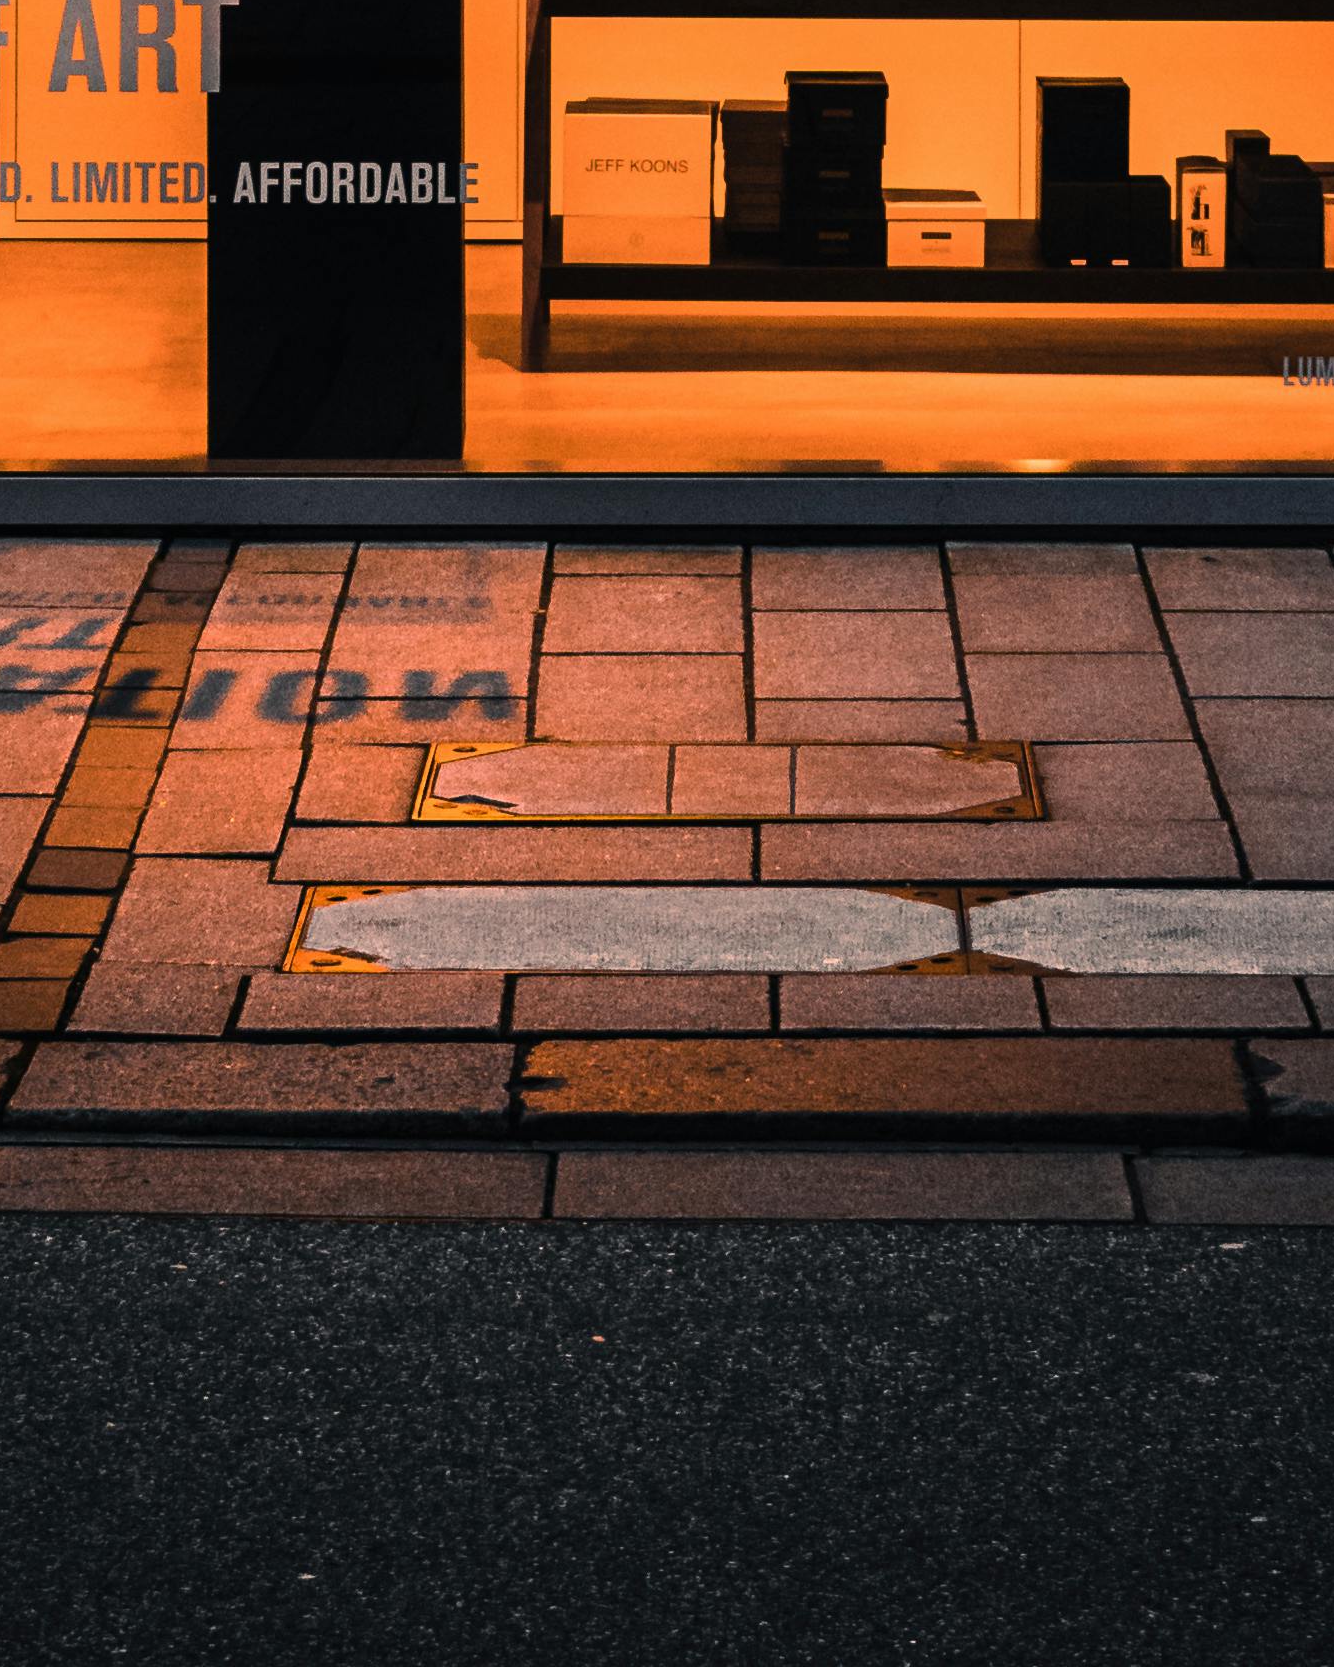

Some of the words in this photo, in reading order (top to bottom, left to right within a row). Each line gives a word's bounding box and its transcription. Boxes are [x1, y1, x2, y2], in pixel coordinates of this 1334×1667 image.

[585, 157, 625, 173] JEFF
[629, 158, 690, 174] KOONS
[50, 161, 218, 205] LIMITED.
[233, 161, 480, 205] AFFORDABLE
